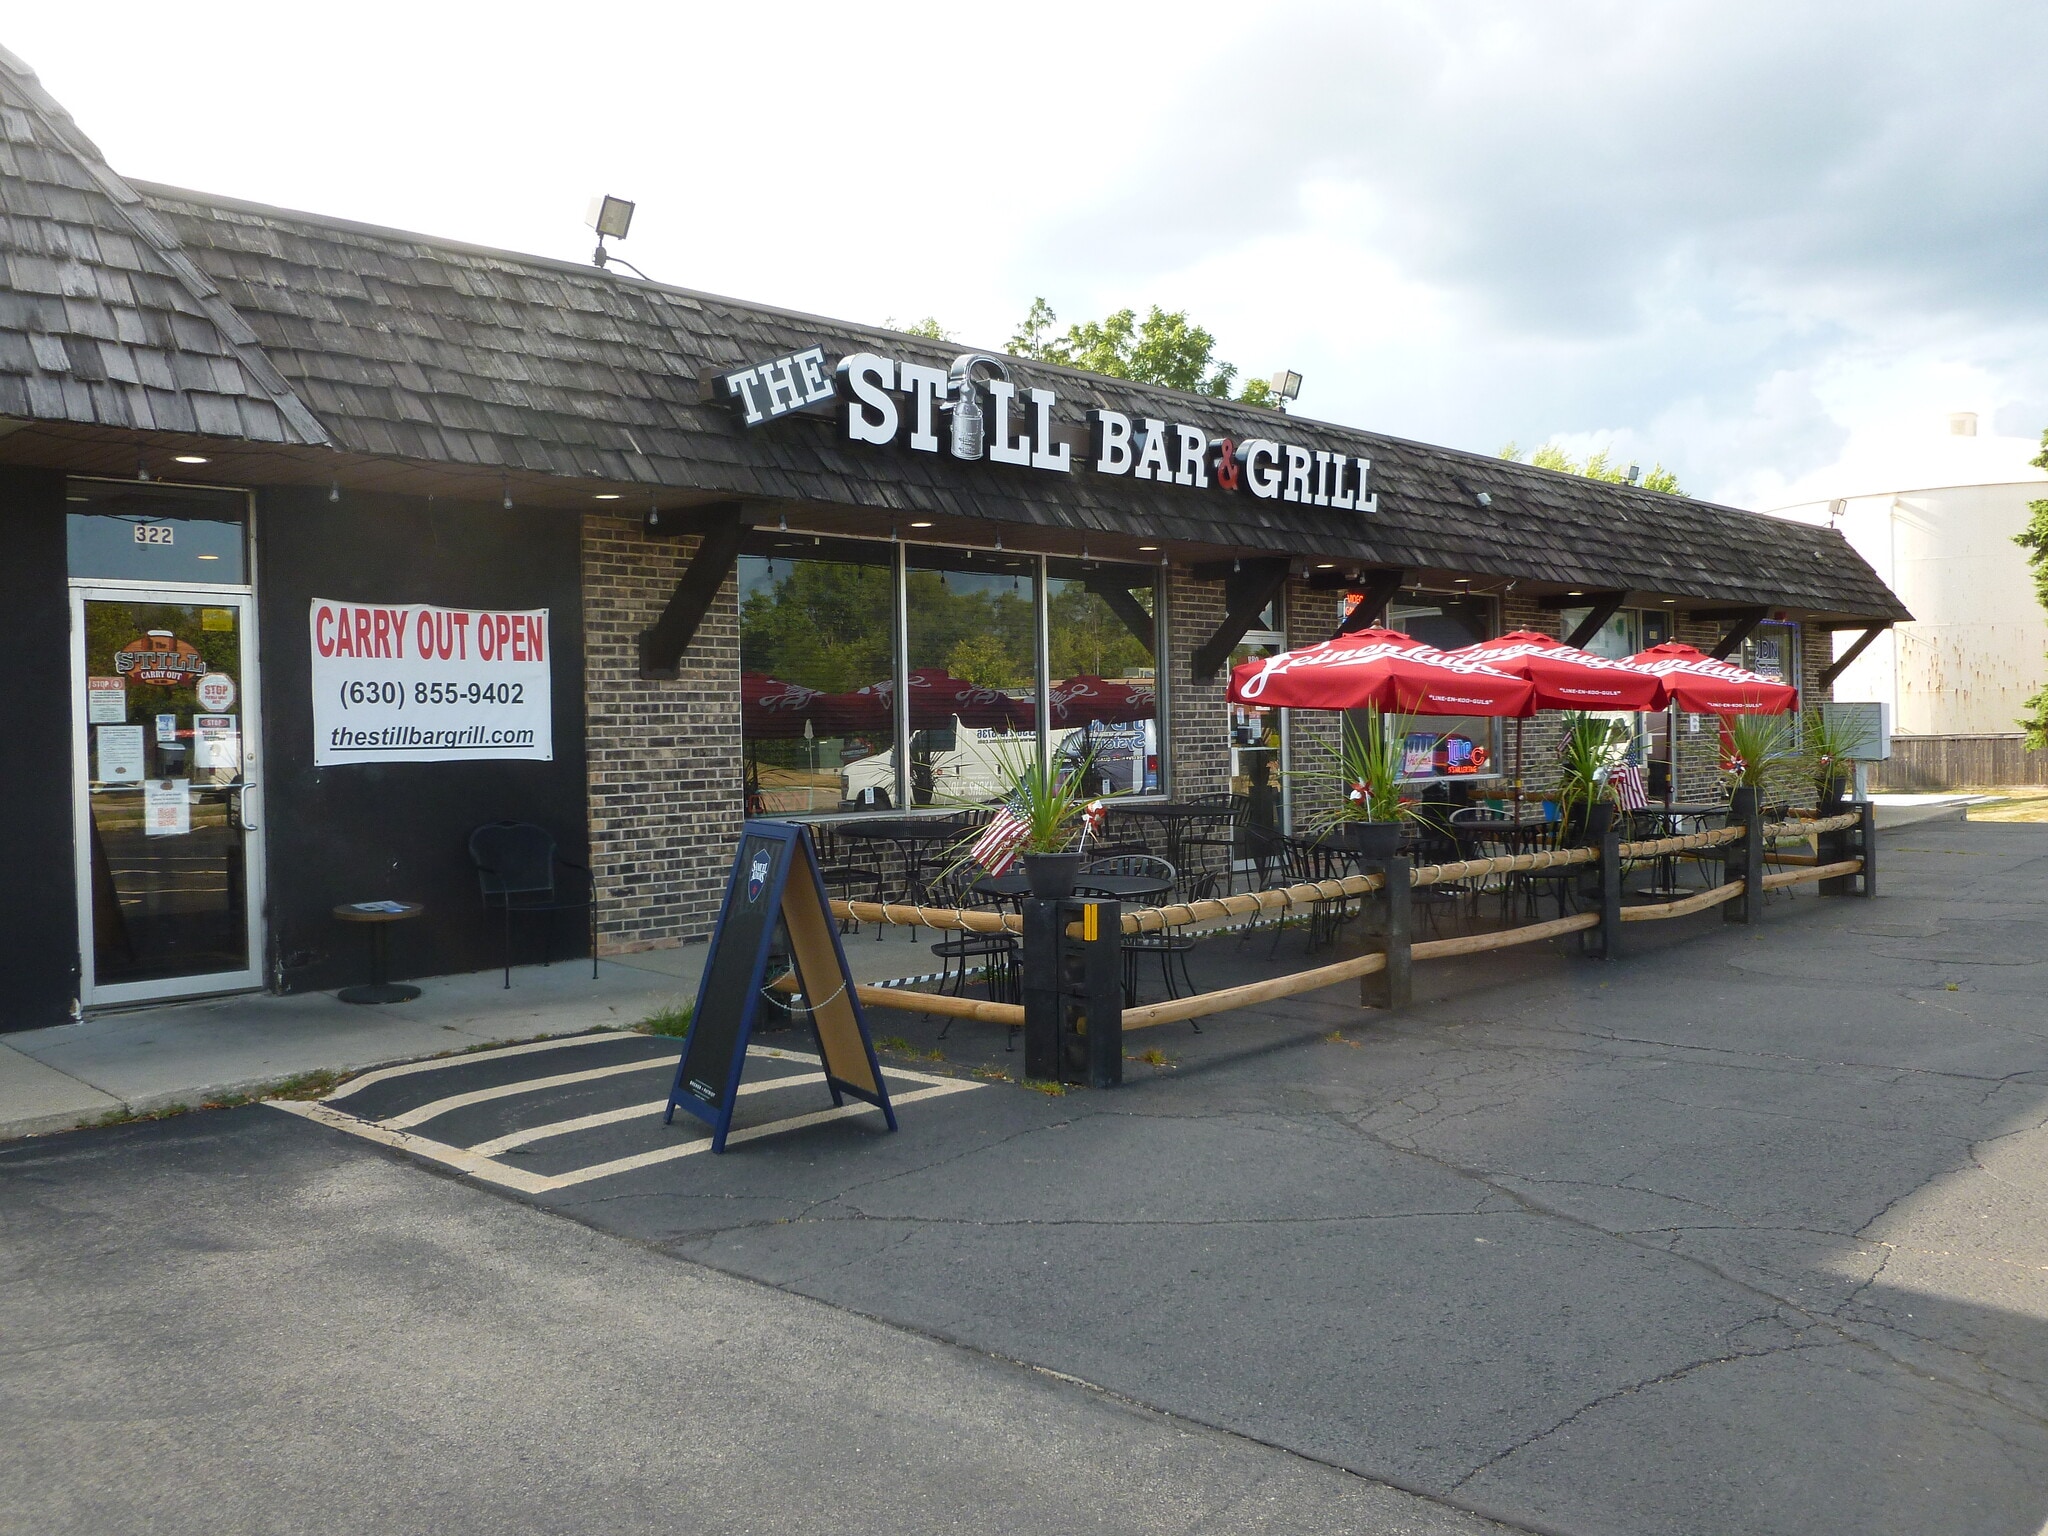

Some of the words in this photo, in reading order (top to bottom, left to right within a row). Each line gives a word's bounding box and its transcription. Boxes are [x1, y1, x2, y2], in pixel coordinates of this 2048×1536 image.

[725, 346, 834, 425] THE
[1096, 409, 1209, 489] BAR
[1217, 437, 1239, 491] &
[1245, 438, 1379, 514] GRILL
[136, 526, 172, 544] 322
[316, 605, 409, 659] CARRY
[416, 610, 470, 661] OUT
[477, 613, 543, 662] OPEN
[1755, 639, 1779, 660] JDN
[115, 650, 207, 676] STILL
[140, 670, 166, 680] CARRY
[166, 671, 183, 681] OUT
[204, 684, 228, 695] STOP
[340, 680, 406, 710] (630)
[414, 682, 525, 704] 855-9402
[330, 725, 535, 750] thestillbargrill.com
